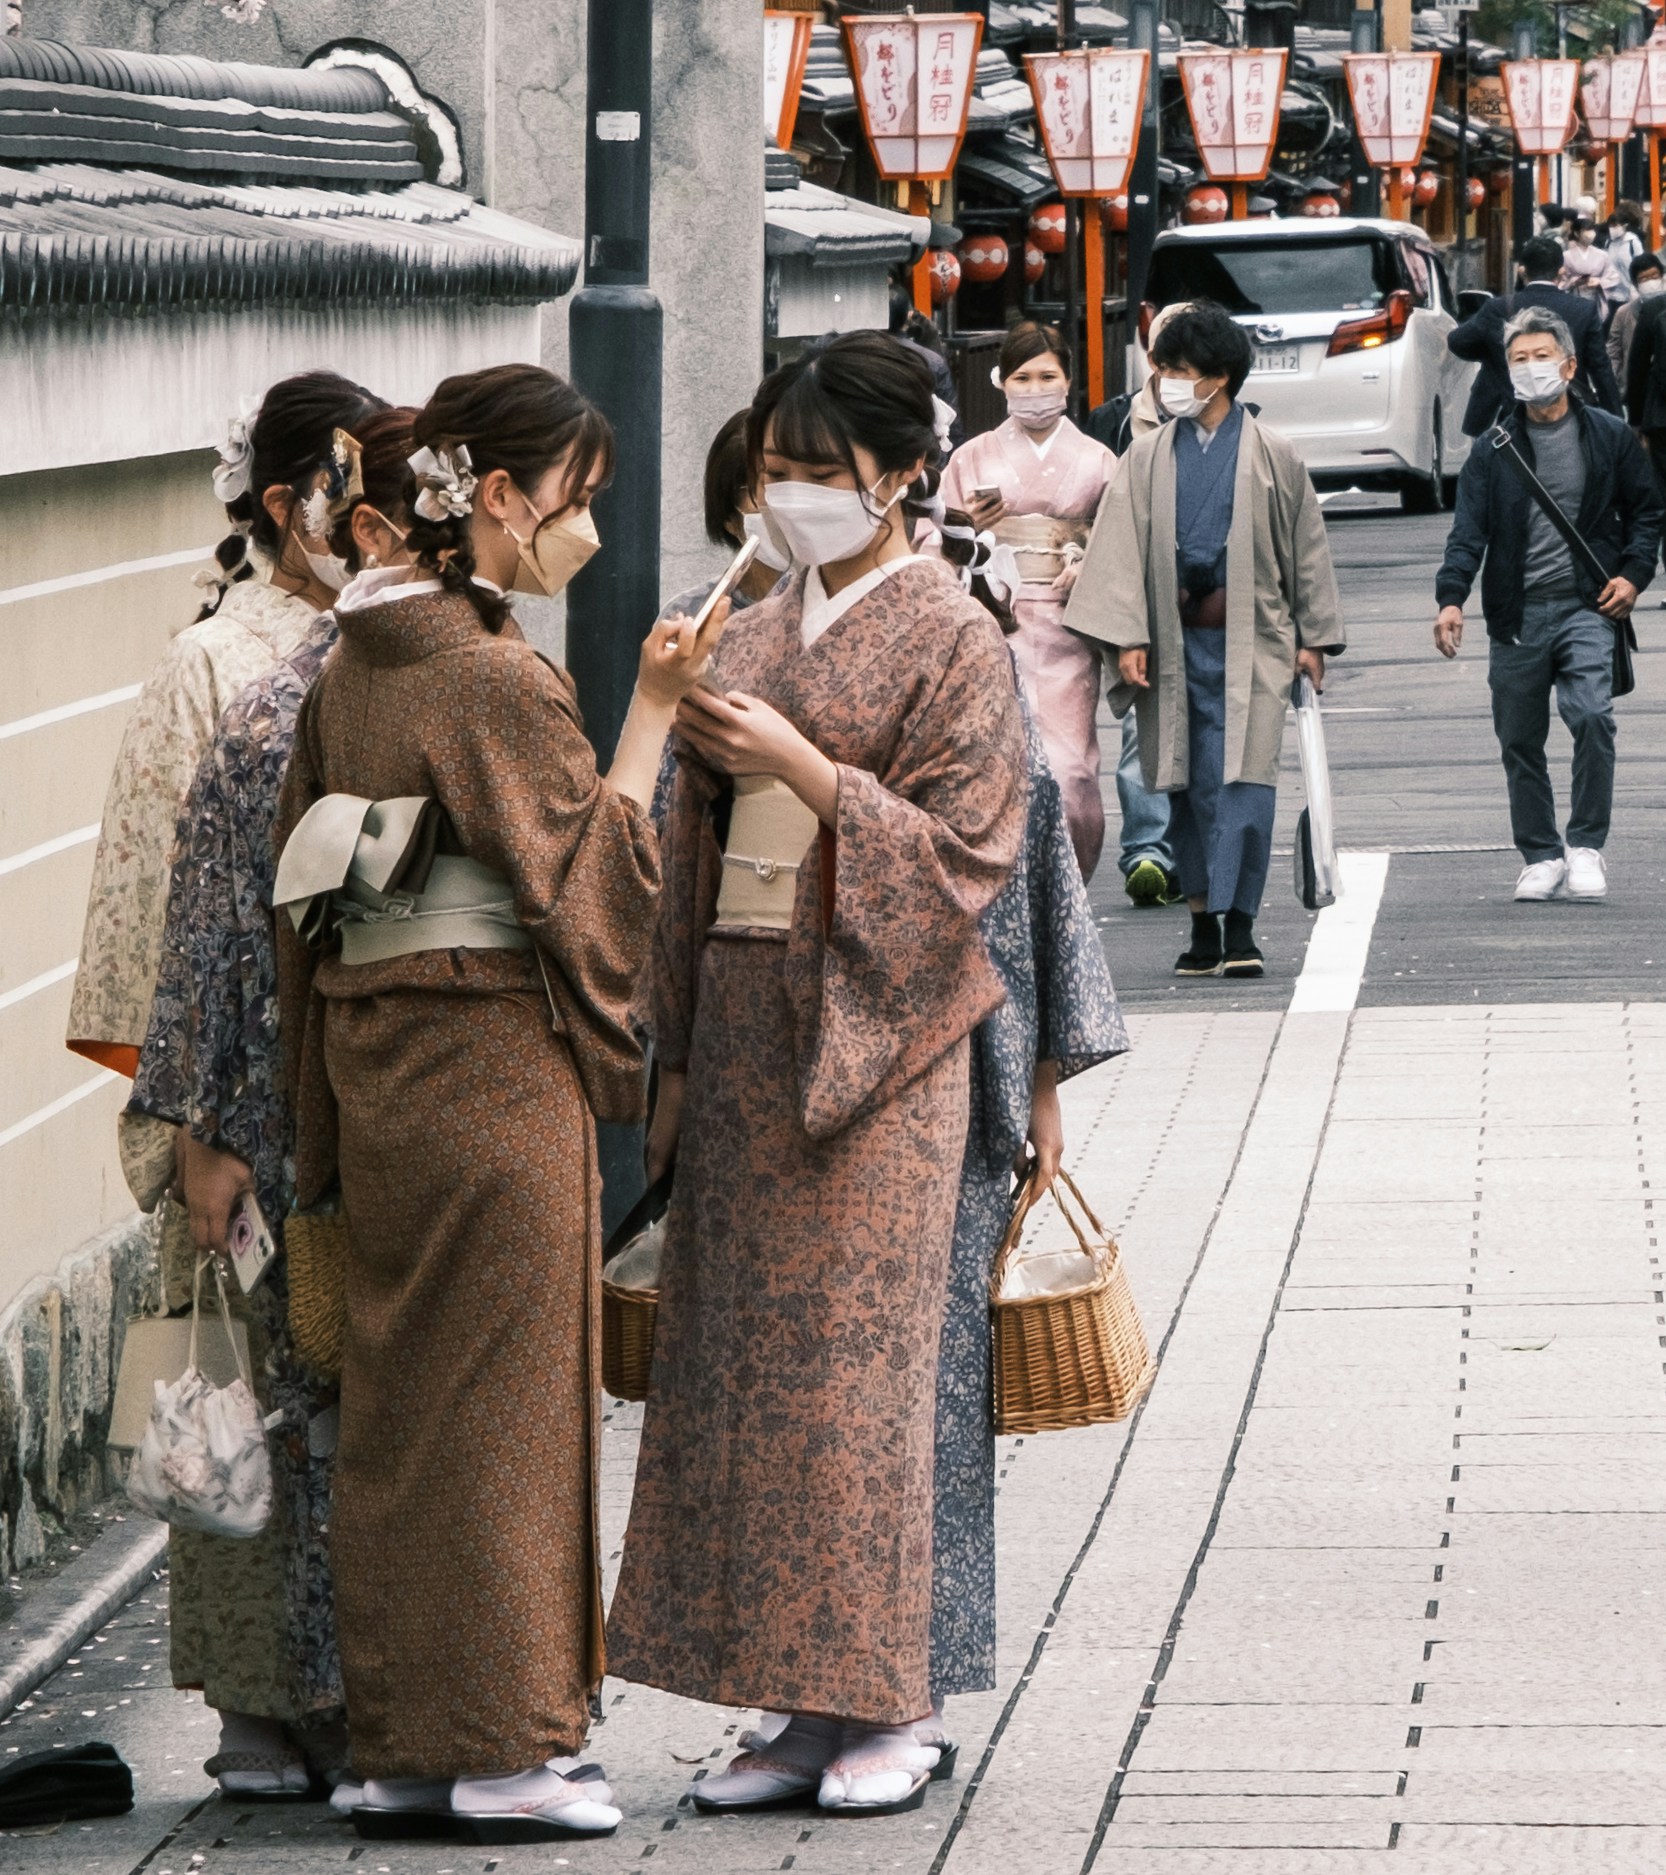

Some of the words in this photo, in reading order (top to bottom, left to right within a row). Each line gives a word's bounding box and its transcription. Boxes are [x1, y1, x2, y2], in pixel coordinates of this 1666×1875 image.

[929, 31, 955, 122] 月桂冠
[1244, 62, 1264, 134] 月桂冠
